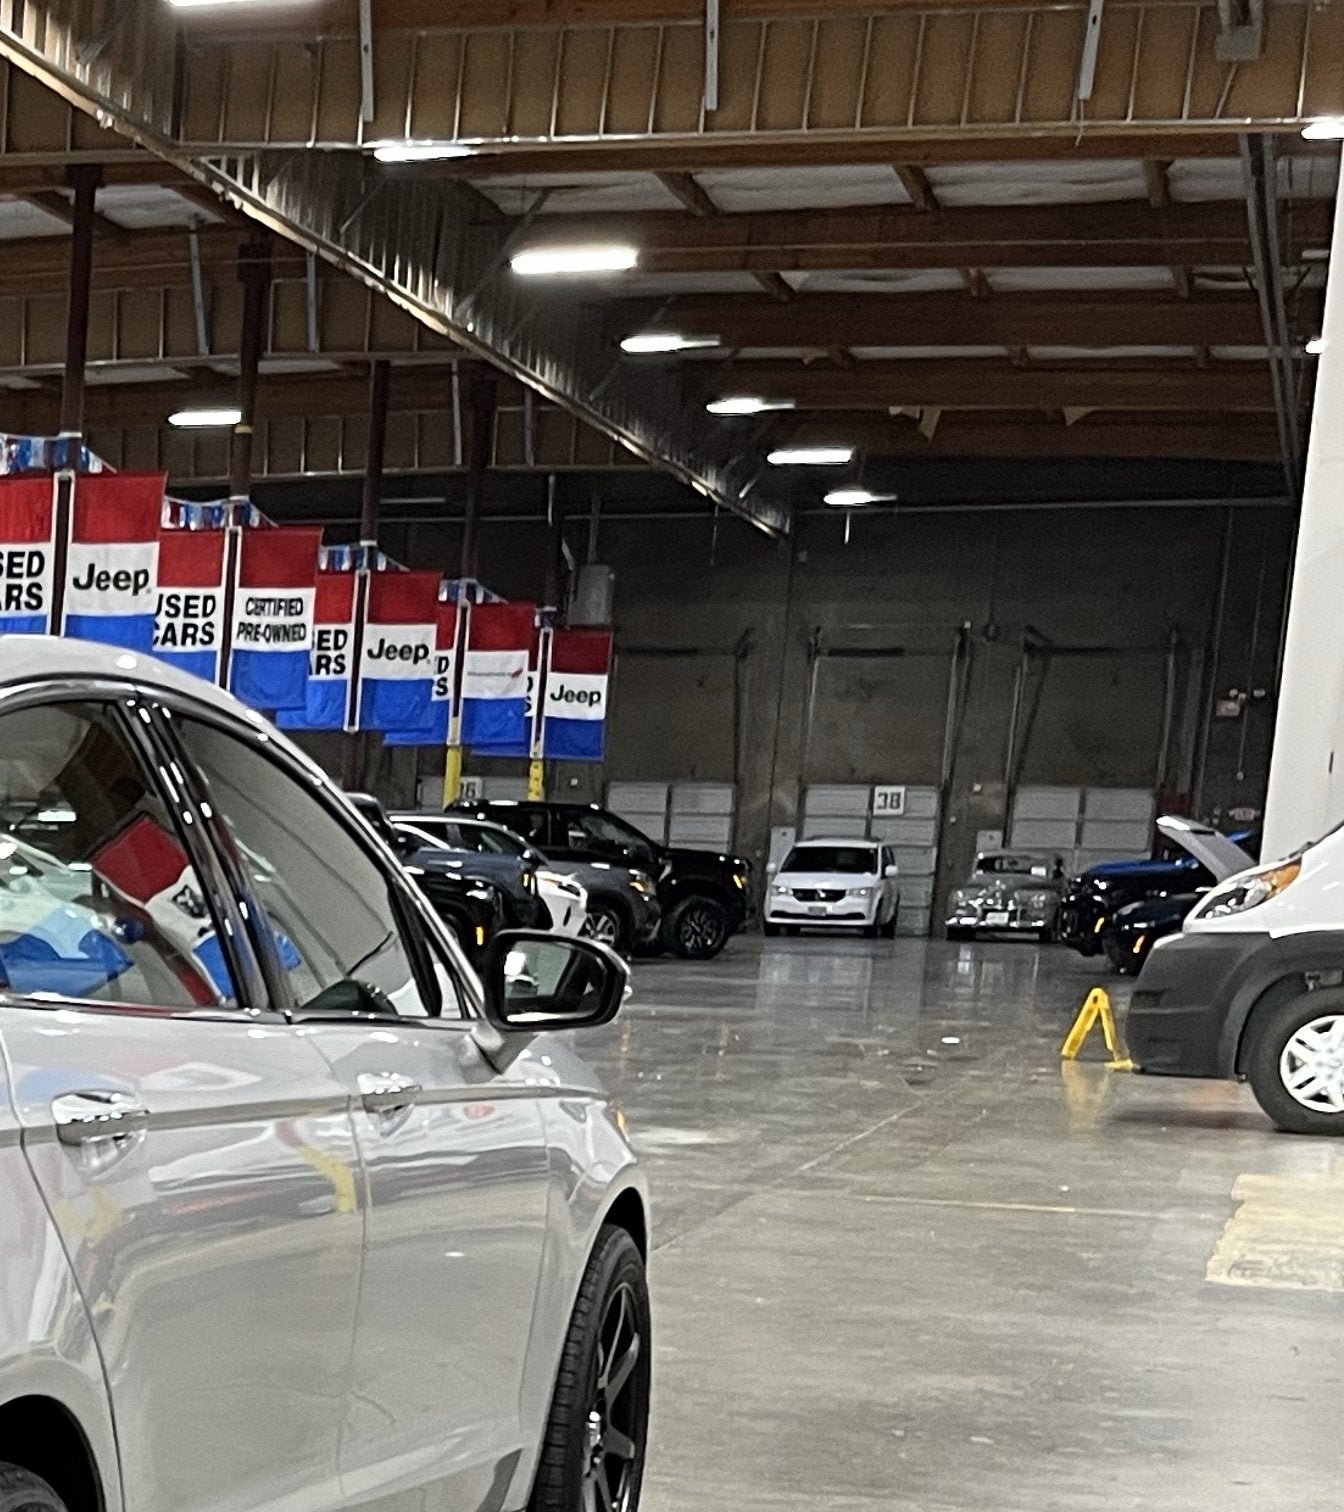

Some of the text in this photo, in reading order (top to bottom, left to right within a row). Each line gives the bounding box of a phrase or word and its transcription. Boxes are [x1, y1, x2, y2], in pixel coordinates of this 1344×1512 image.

[72, 563, 149, 597] Jeep
[245, 597, 304, 617] CERTIFIED
[236, 622, 307, 643] PRE-OWNED
[315, 629, 348, 651] ED
[367, 638, 430, 665] Jeep
[315, 653, 347, 676] RS
[550, 684, 602, 707] Jeep
[876, 791, 902, 811] 38
